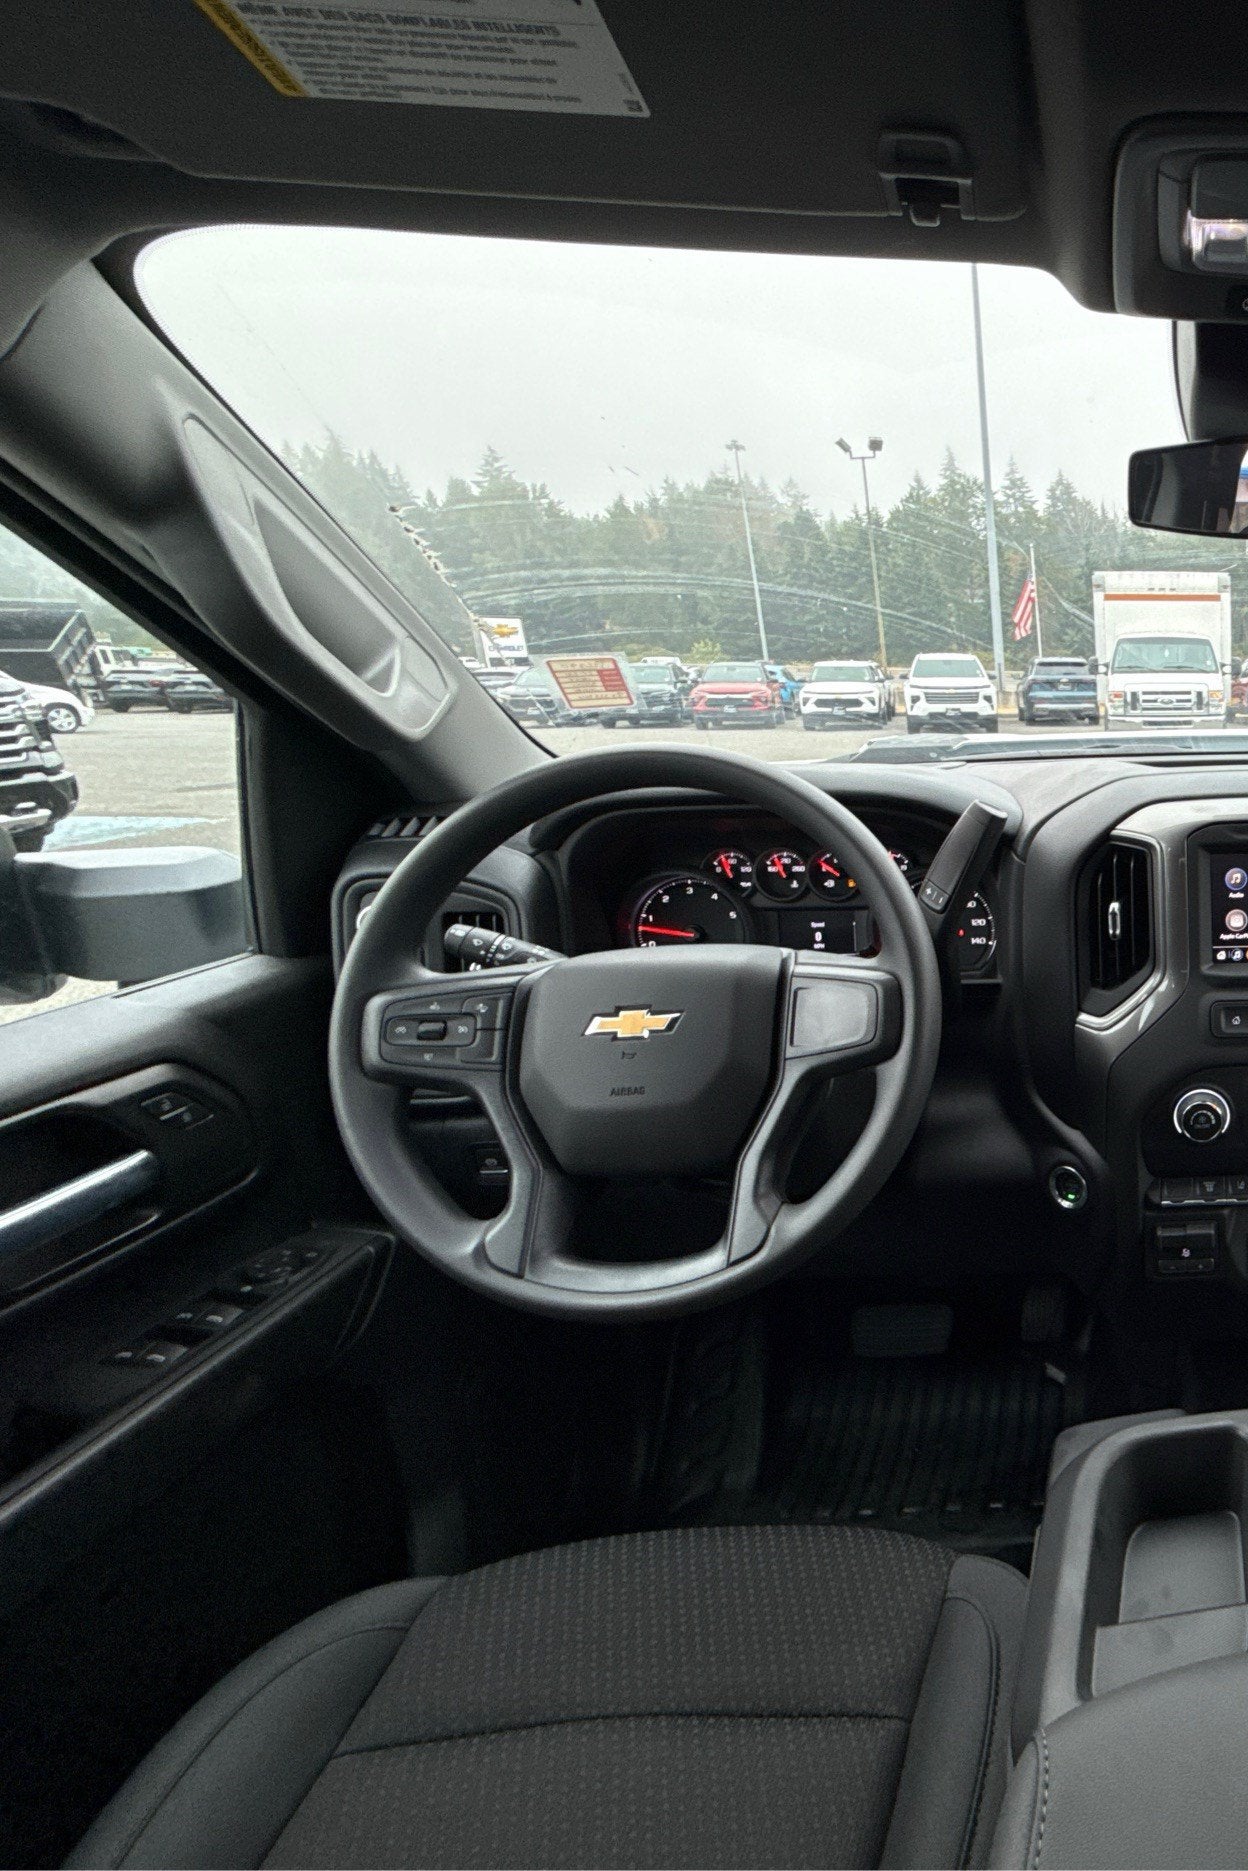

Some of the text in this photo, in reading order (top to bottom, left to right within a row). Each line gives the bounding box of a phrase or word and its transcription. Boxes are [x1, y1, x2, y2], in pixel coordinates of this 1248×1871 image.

[686, 887, 693, 895] 3
[662, 895, 670, 903] 2
[711, 893, 718, 901] 4
[648, 914, 653, 922] 1
[729, 911, 737, 919] 5
[971, 918, 987, 926] 120
[814, 931, 822, 942] 0
[970, 937, 987, 945] 140
[610, 1086, 646, 1097] AIRBAG
